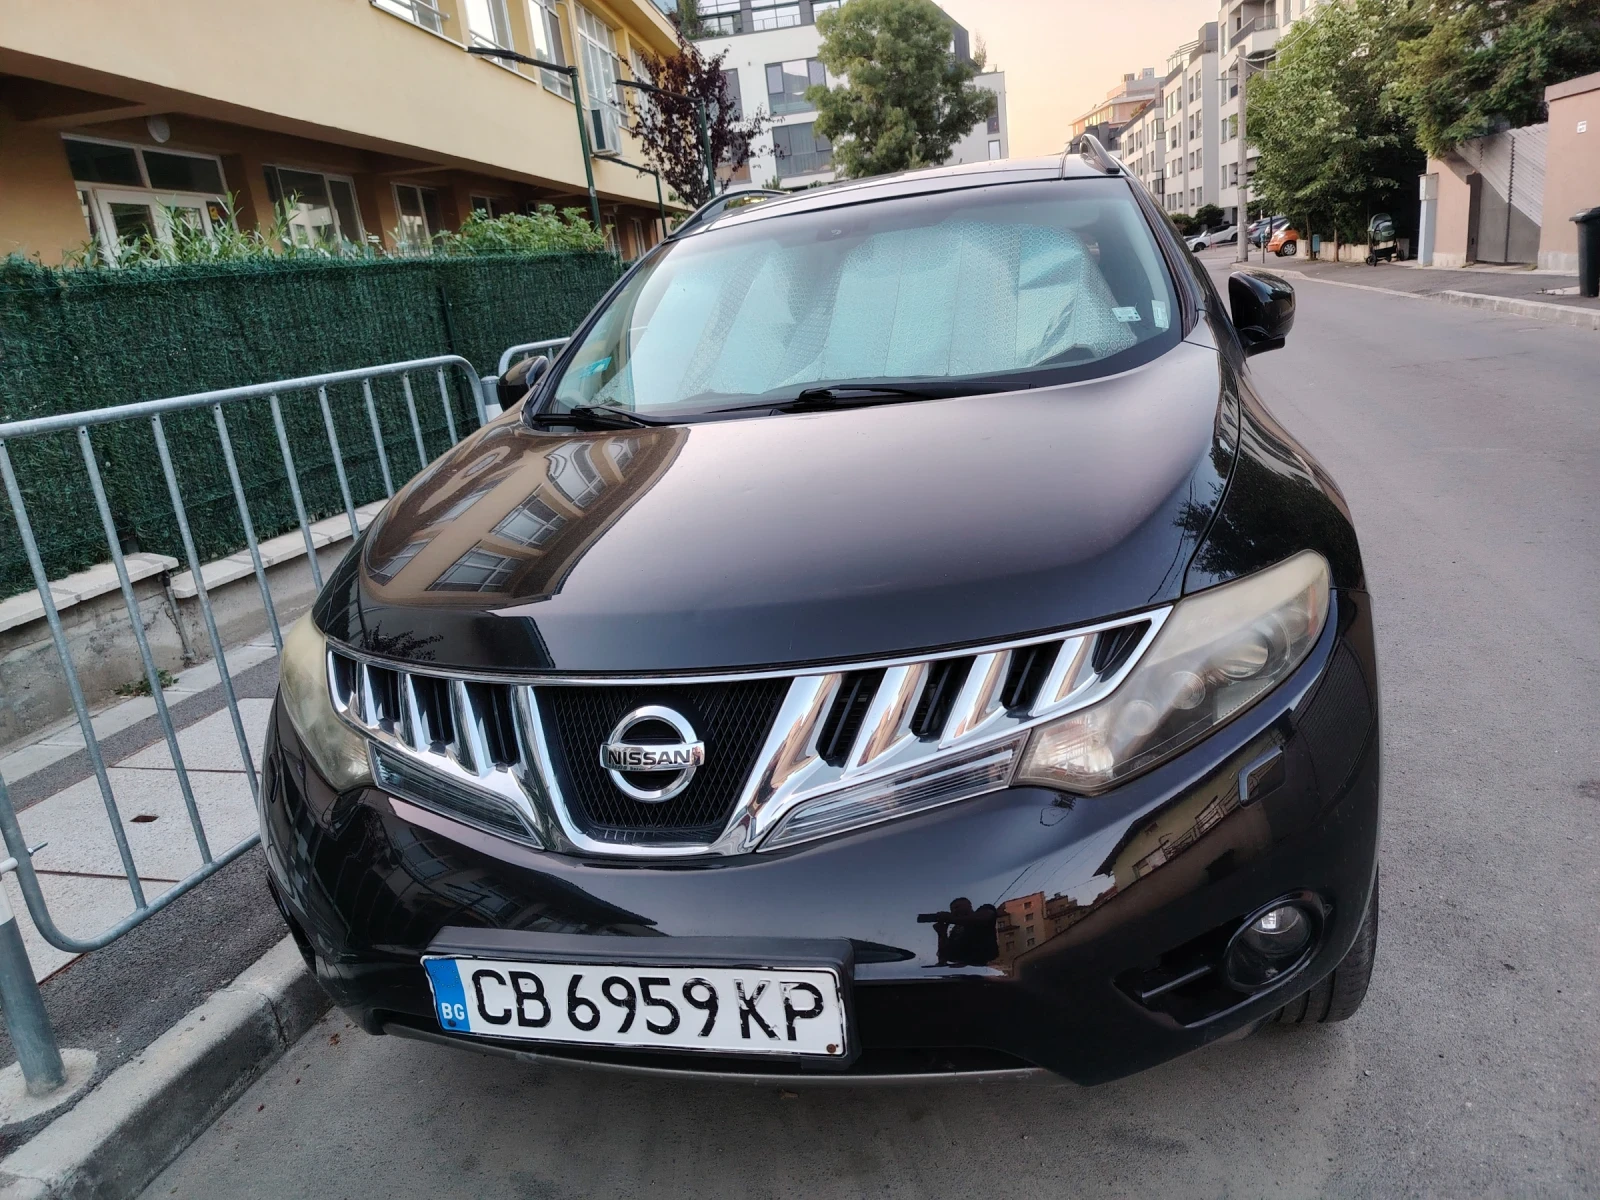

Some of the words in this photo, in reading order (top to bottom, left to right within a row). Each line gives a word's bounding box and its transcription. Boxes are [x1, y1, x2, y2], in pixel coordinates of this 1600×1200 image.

[608, 750, 690, 766] NISSAN
[441, 1002, 465, 1020] BG
[472, 969, 551, 1028] CB
[567, 974, 719, 1037] 6959
[734, 978, 824, 1041] KP
